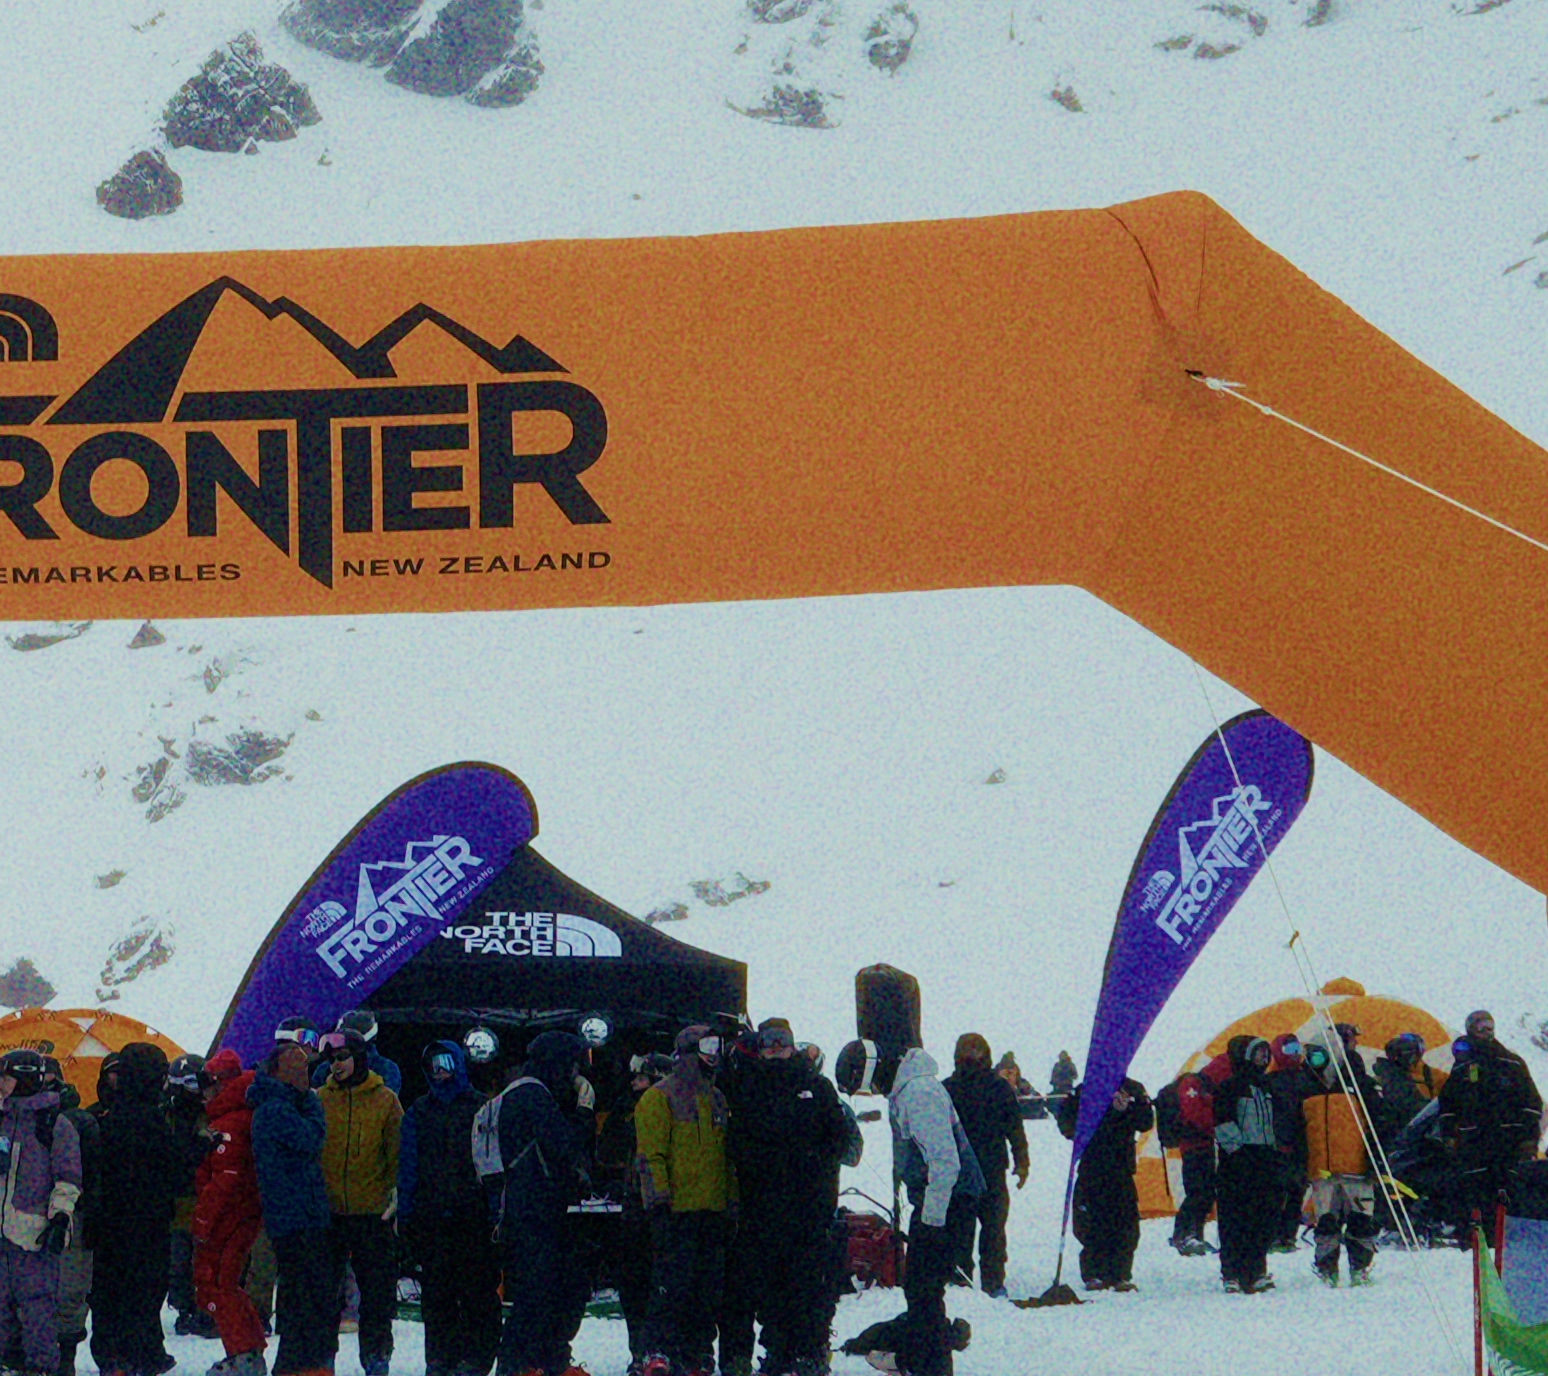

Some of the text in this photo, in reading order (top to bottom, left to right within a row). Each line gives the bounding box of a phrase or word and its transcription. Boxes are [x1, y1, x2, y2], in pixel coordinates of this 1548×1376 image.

[342, 557, 426, 578] NEW
[438, 551, 612, 576] ZEALAND
[1155, 784, 1273, 945] FRONTIER
[315, 835, 484, 980] FRONTIER
[485, 911, 554, 926] THE
[464, 940, 554, 956] FACE
